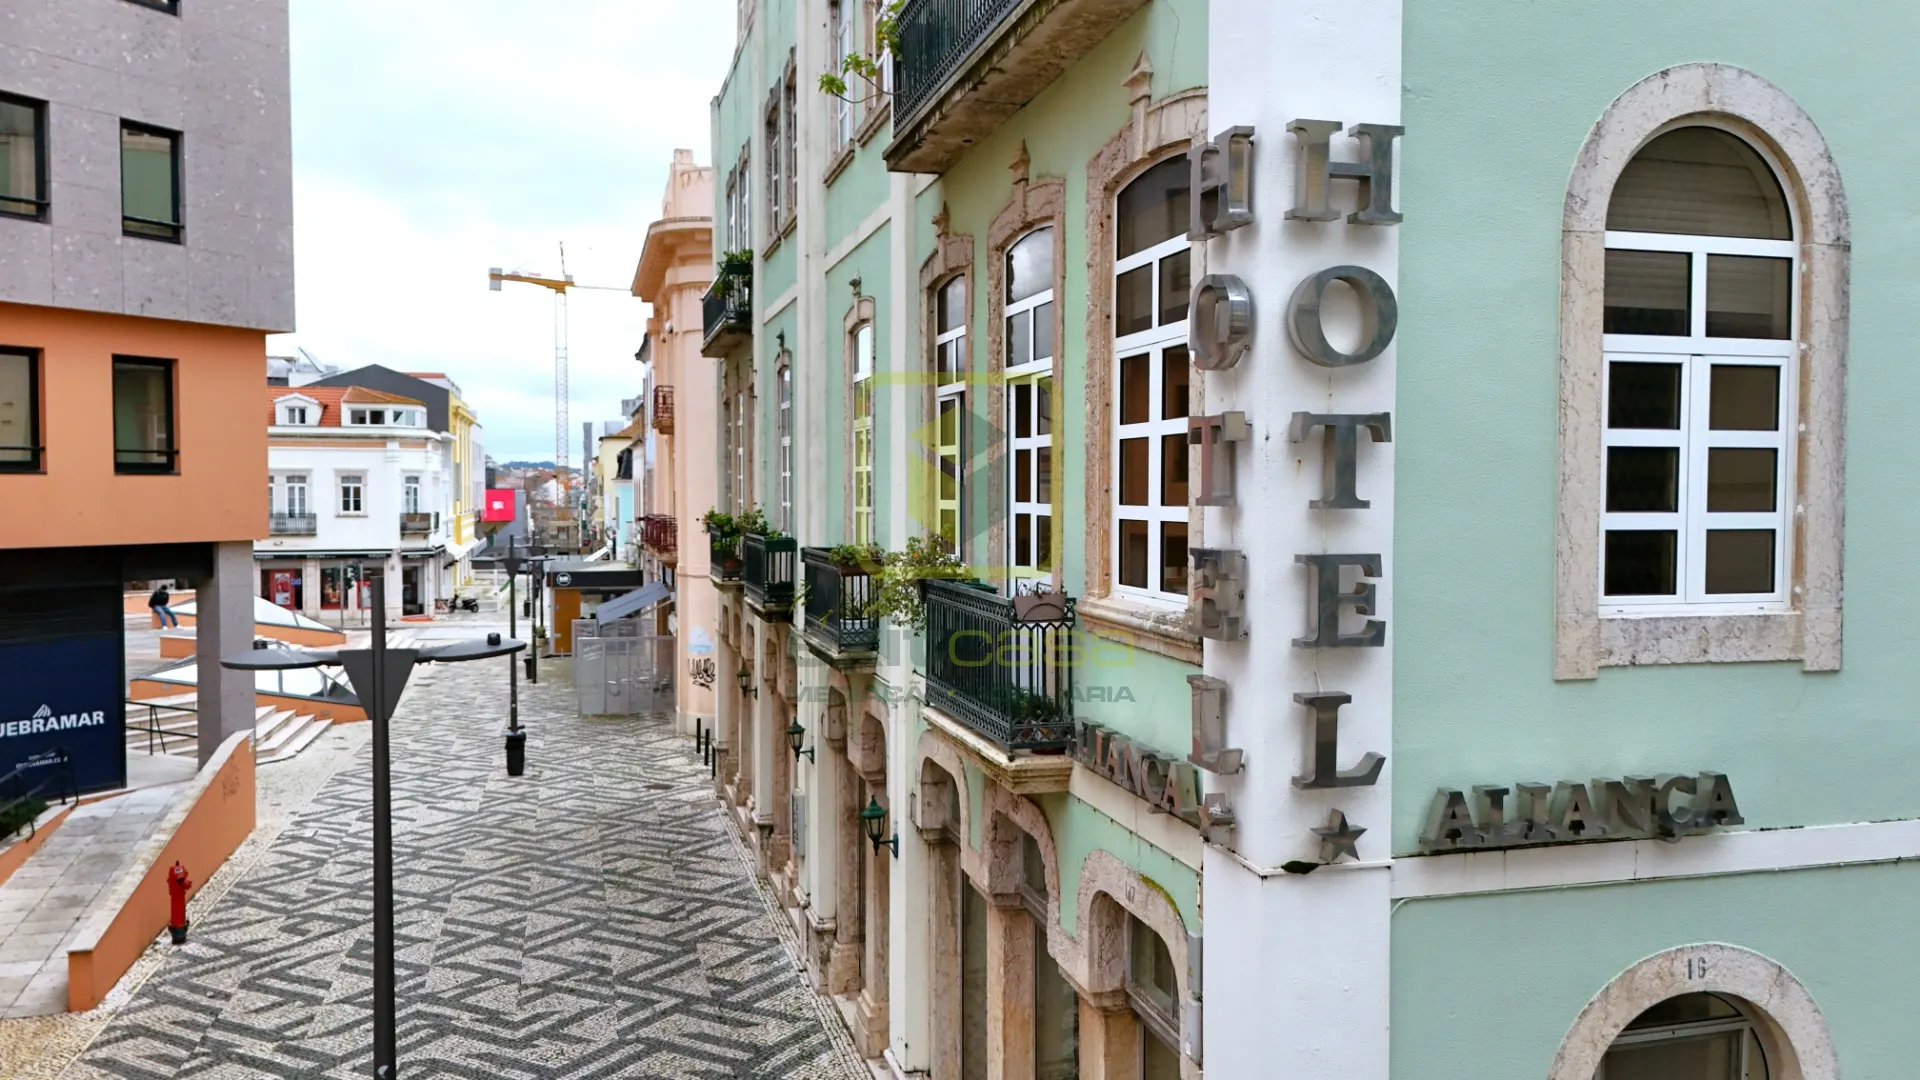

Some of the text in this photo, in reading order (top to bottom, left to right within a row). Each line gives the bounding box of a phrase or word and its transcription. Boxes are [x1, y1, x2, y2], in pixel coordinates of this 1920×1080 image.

[1186, 125, 1255, 775] HOTEL
[1284, 118, 1405, 790] HOTEL
[1418, 771, 1745, 844] ALIANÇA
[1687, 956, 1706, 980] 16
